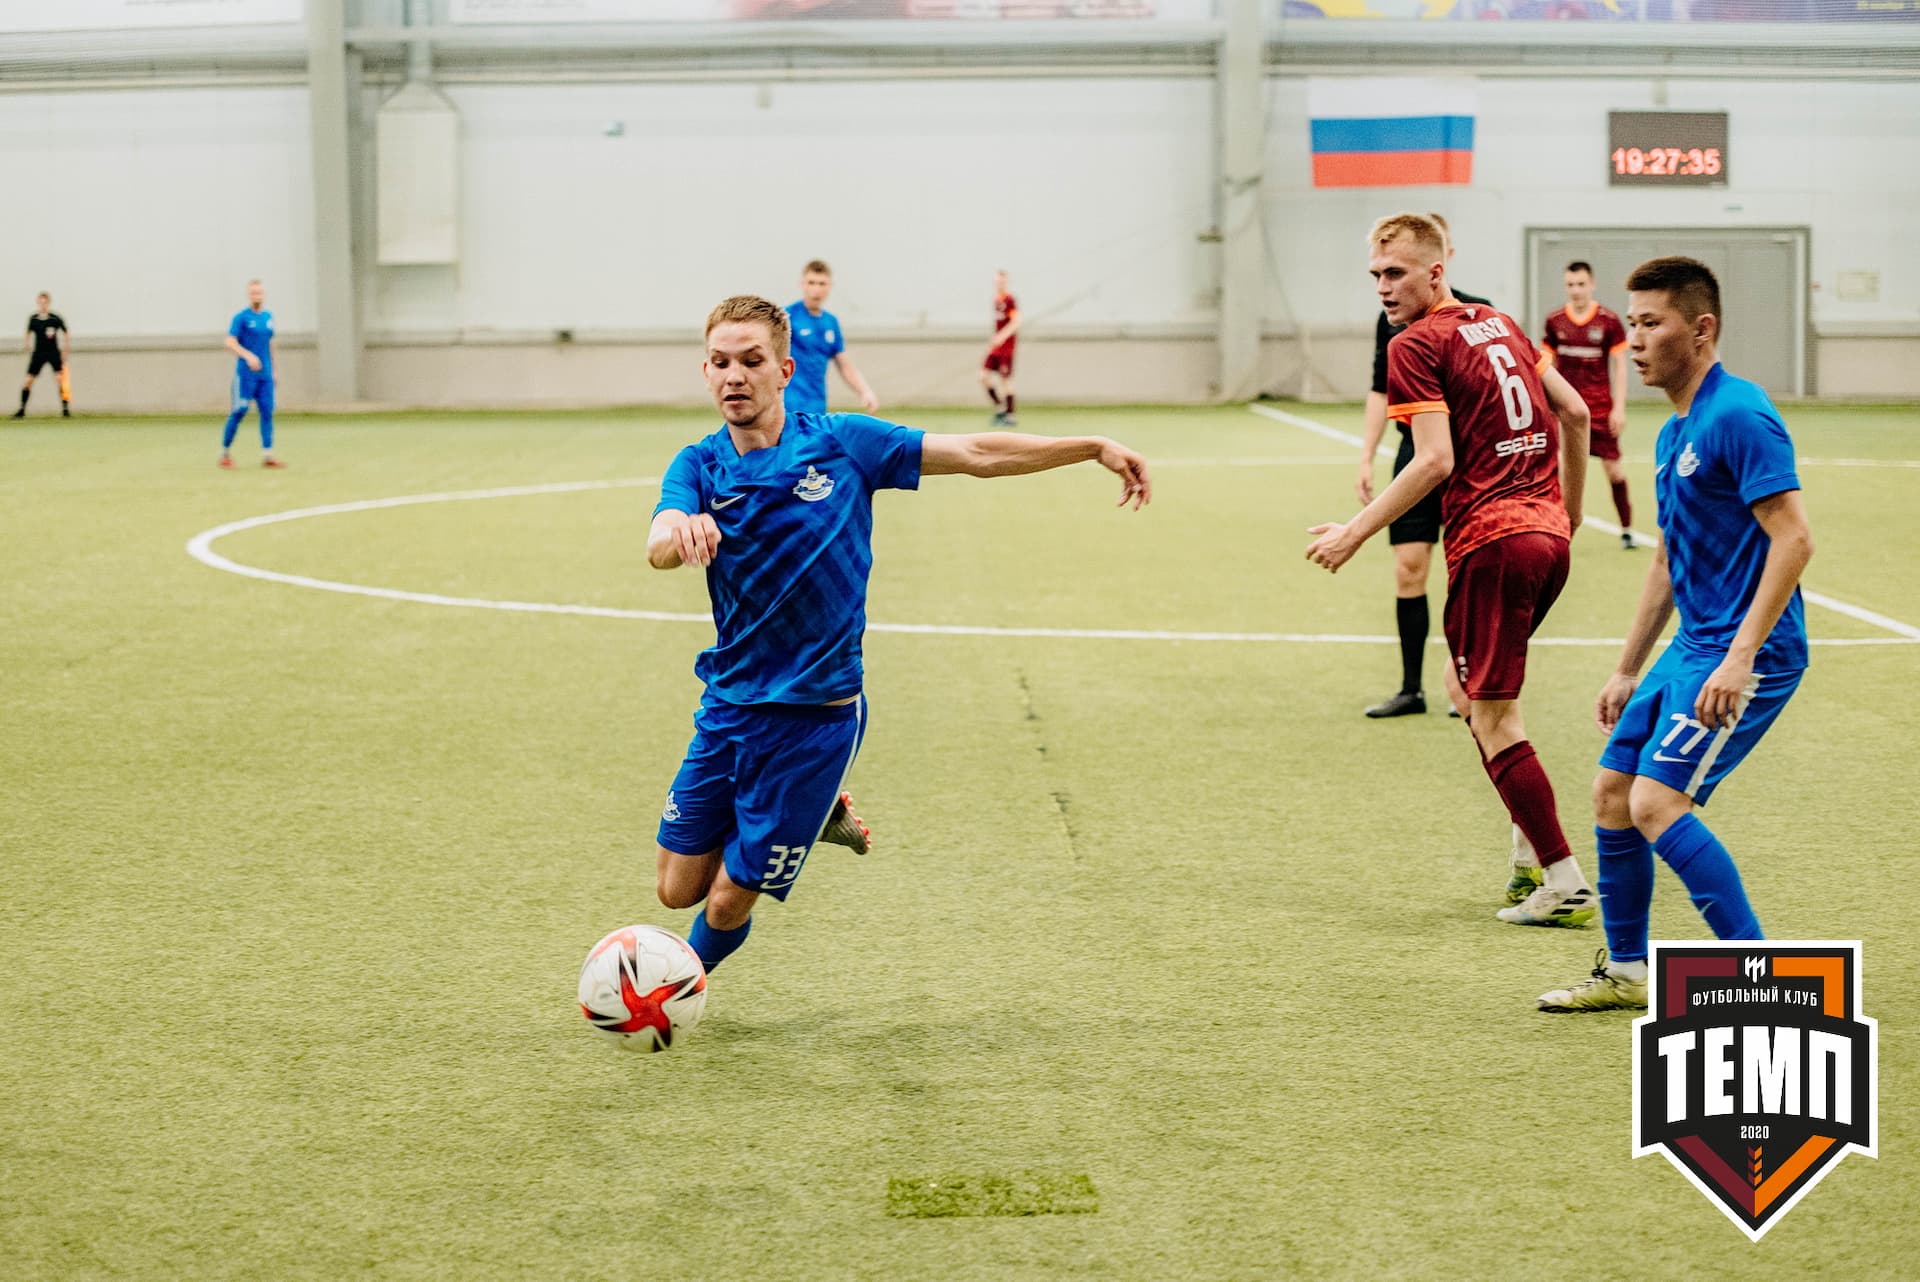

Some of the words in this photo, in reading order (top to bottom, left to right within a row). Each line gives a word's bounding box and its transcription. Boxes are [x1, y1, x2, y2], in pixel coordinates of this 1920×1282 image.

[1611, 147, 1721, 175] 19:27:35
[1486, 343, 1533, 431] 6
[1660, 712, 1710, 755] 77
[763, 845, 807, 879] 33
